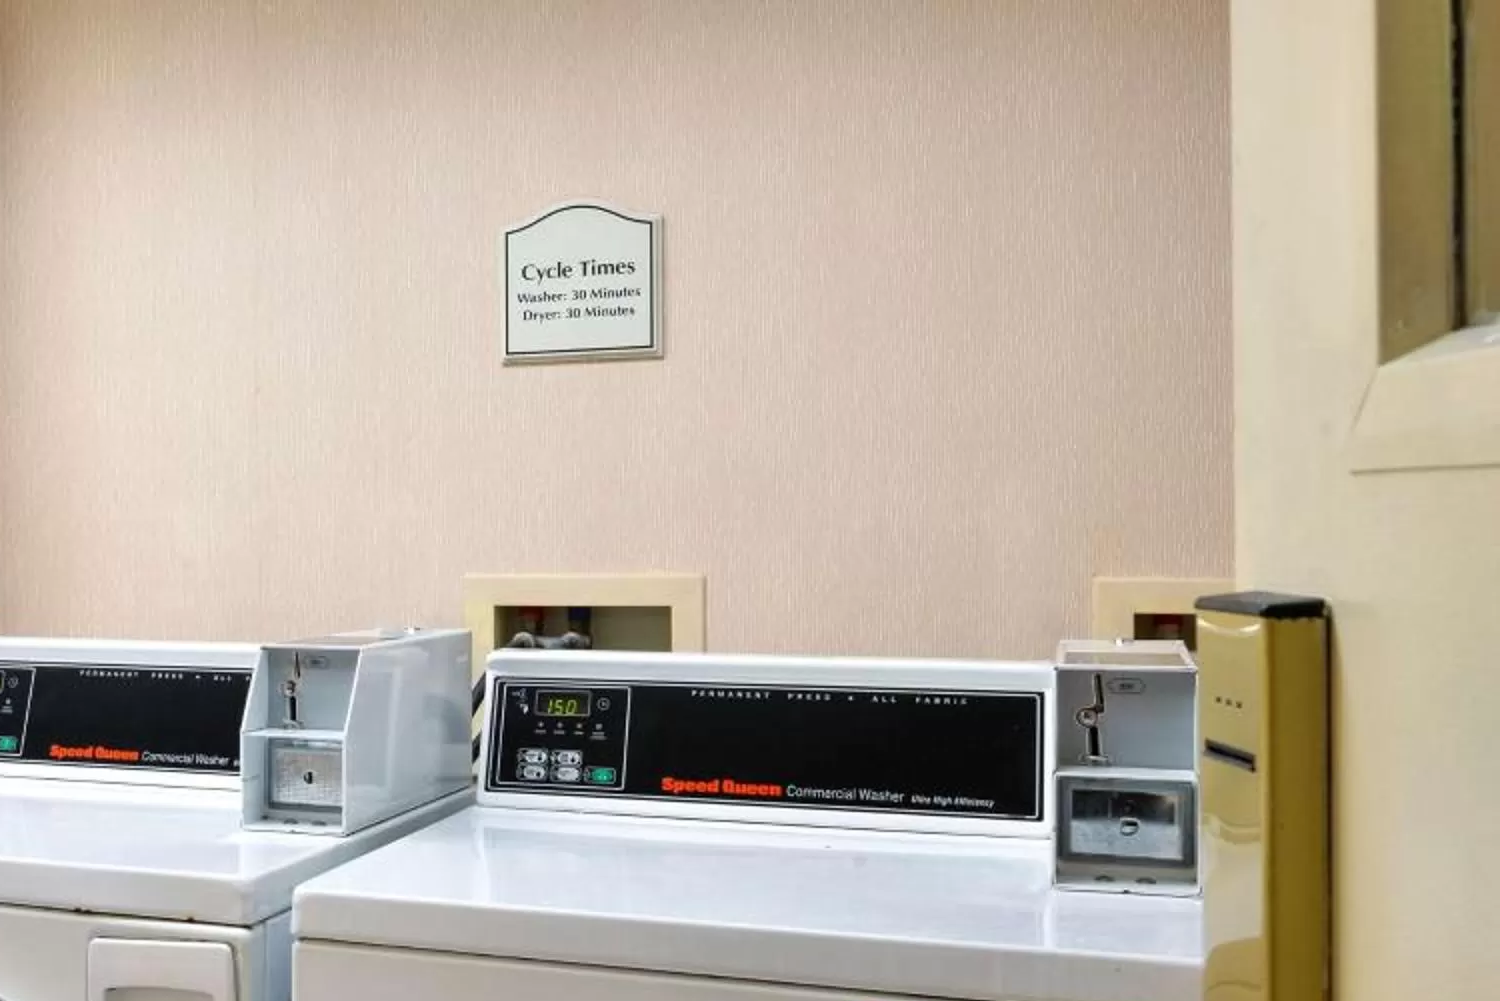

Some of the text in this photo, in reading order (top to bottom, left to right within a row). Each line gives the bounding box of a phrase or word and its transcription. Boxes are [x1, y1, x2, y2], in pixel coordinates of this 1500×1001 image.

[521, 259, 637, 285] Cycle Times
[517, 286, 642, 304] Washer: 30 Minutes
[523, 305, 636, 324] Dryer: 30 Minutes
[691, 689, 770, 699] PERMANENT
[872, 695, 897, 704] ALL
[547, 699, 578, 715] 150
[49, 744, 93, 760] Speed
[95, 746, 139, 761] Queen
[141, 751, 194, 764] Commercial
[195, 753, 229, 766] Washer
[661, 776, 719, 794] Speed
[722, 779, 782, 797] Queen
[786, 783, 857, 801] Commercial
[858, 788, 905, 803] Washer
